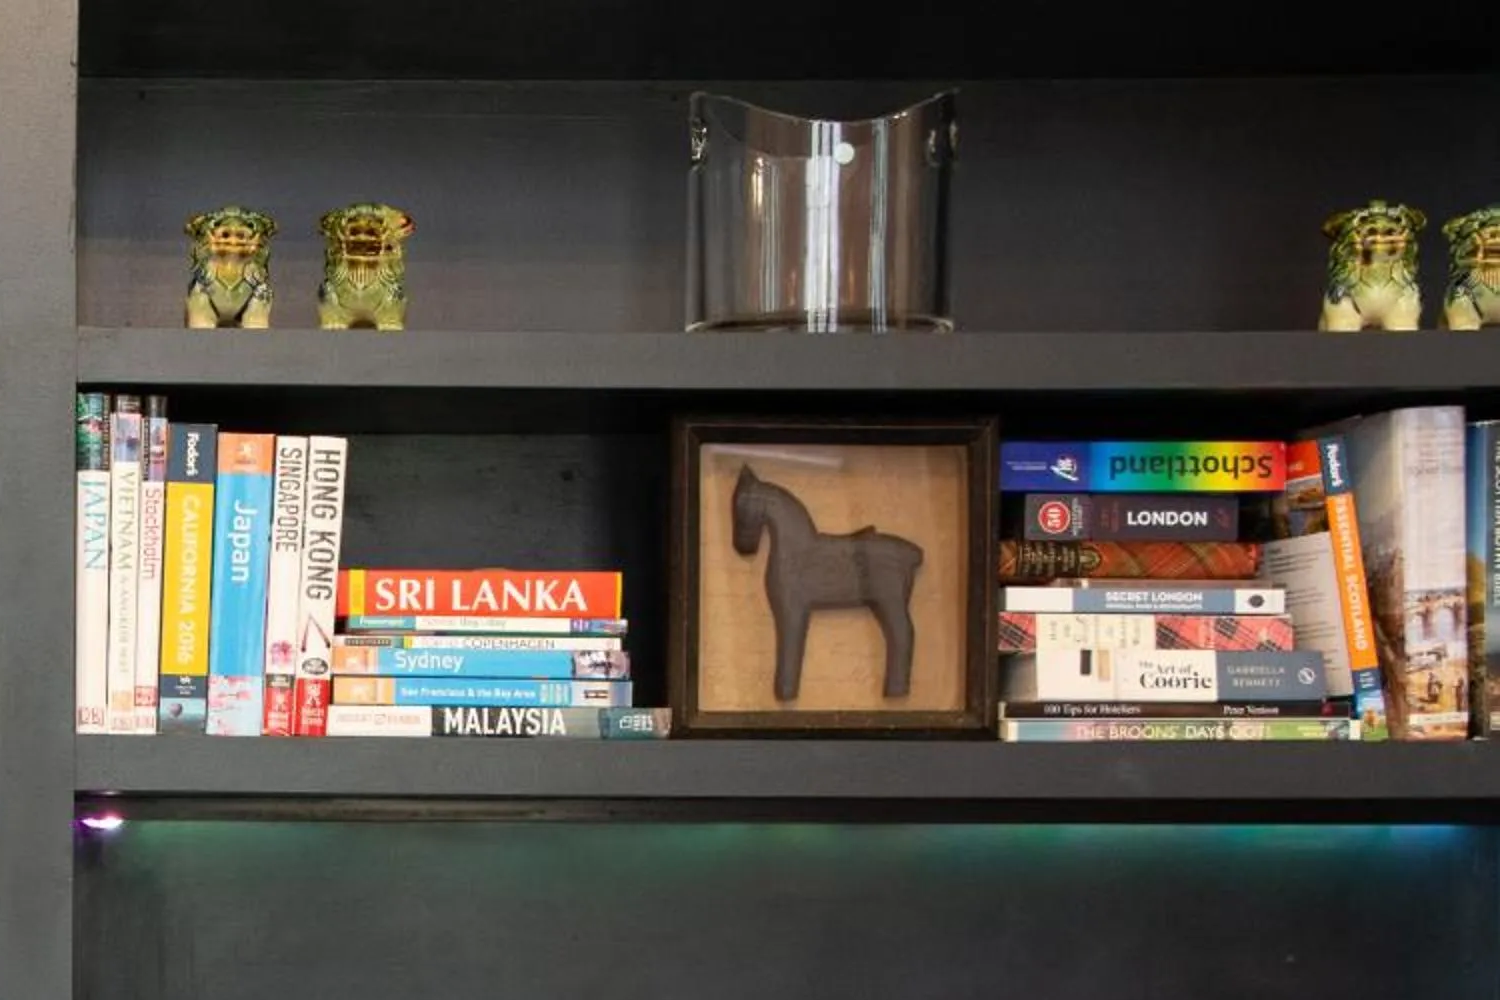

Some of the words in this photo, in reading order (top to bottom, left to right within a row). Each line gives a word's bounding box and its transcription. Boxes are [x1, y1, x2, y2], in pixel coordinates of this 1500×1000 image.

[1109, 455, 1273, 479] Schottland
[311, 449, 340, 520] HONG
[276, 448, 301, 553] SINGAPORE
[81, 480, 106, 570] JAPAN
[1127, 511, 1207, 526] LONDON
[178, 496, 200, 613] CALIFORNIA
[229, 501, 257, 584] Japan
[307, 531, 335, 600] KONG
[376, 578, 434, 610] SRI
[452, 578, 587, 611] LANKA
[1106, 591, 1147, 602] SECRET
[1151, 591, 1203, 602] LONDON
[395, 652, 463, 672] Sydney
[1227, 665, 1285, 676] GABRIELLA
[444, 708, 566, 734] MALAYSIA
[1062, 706, 1082, 716] Tips
[1085, 705, 1097, 714] for
